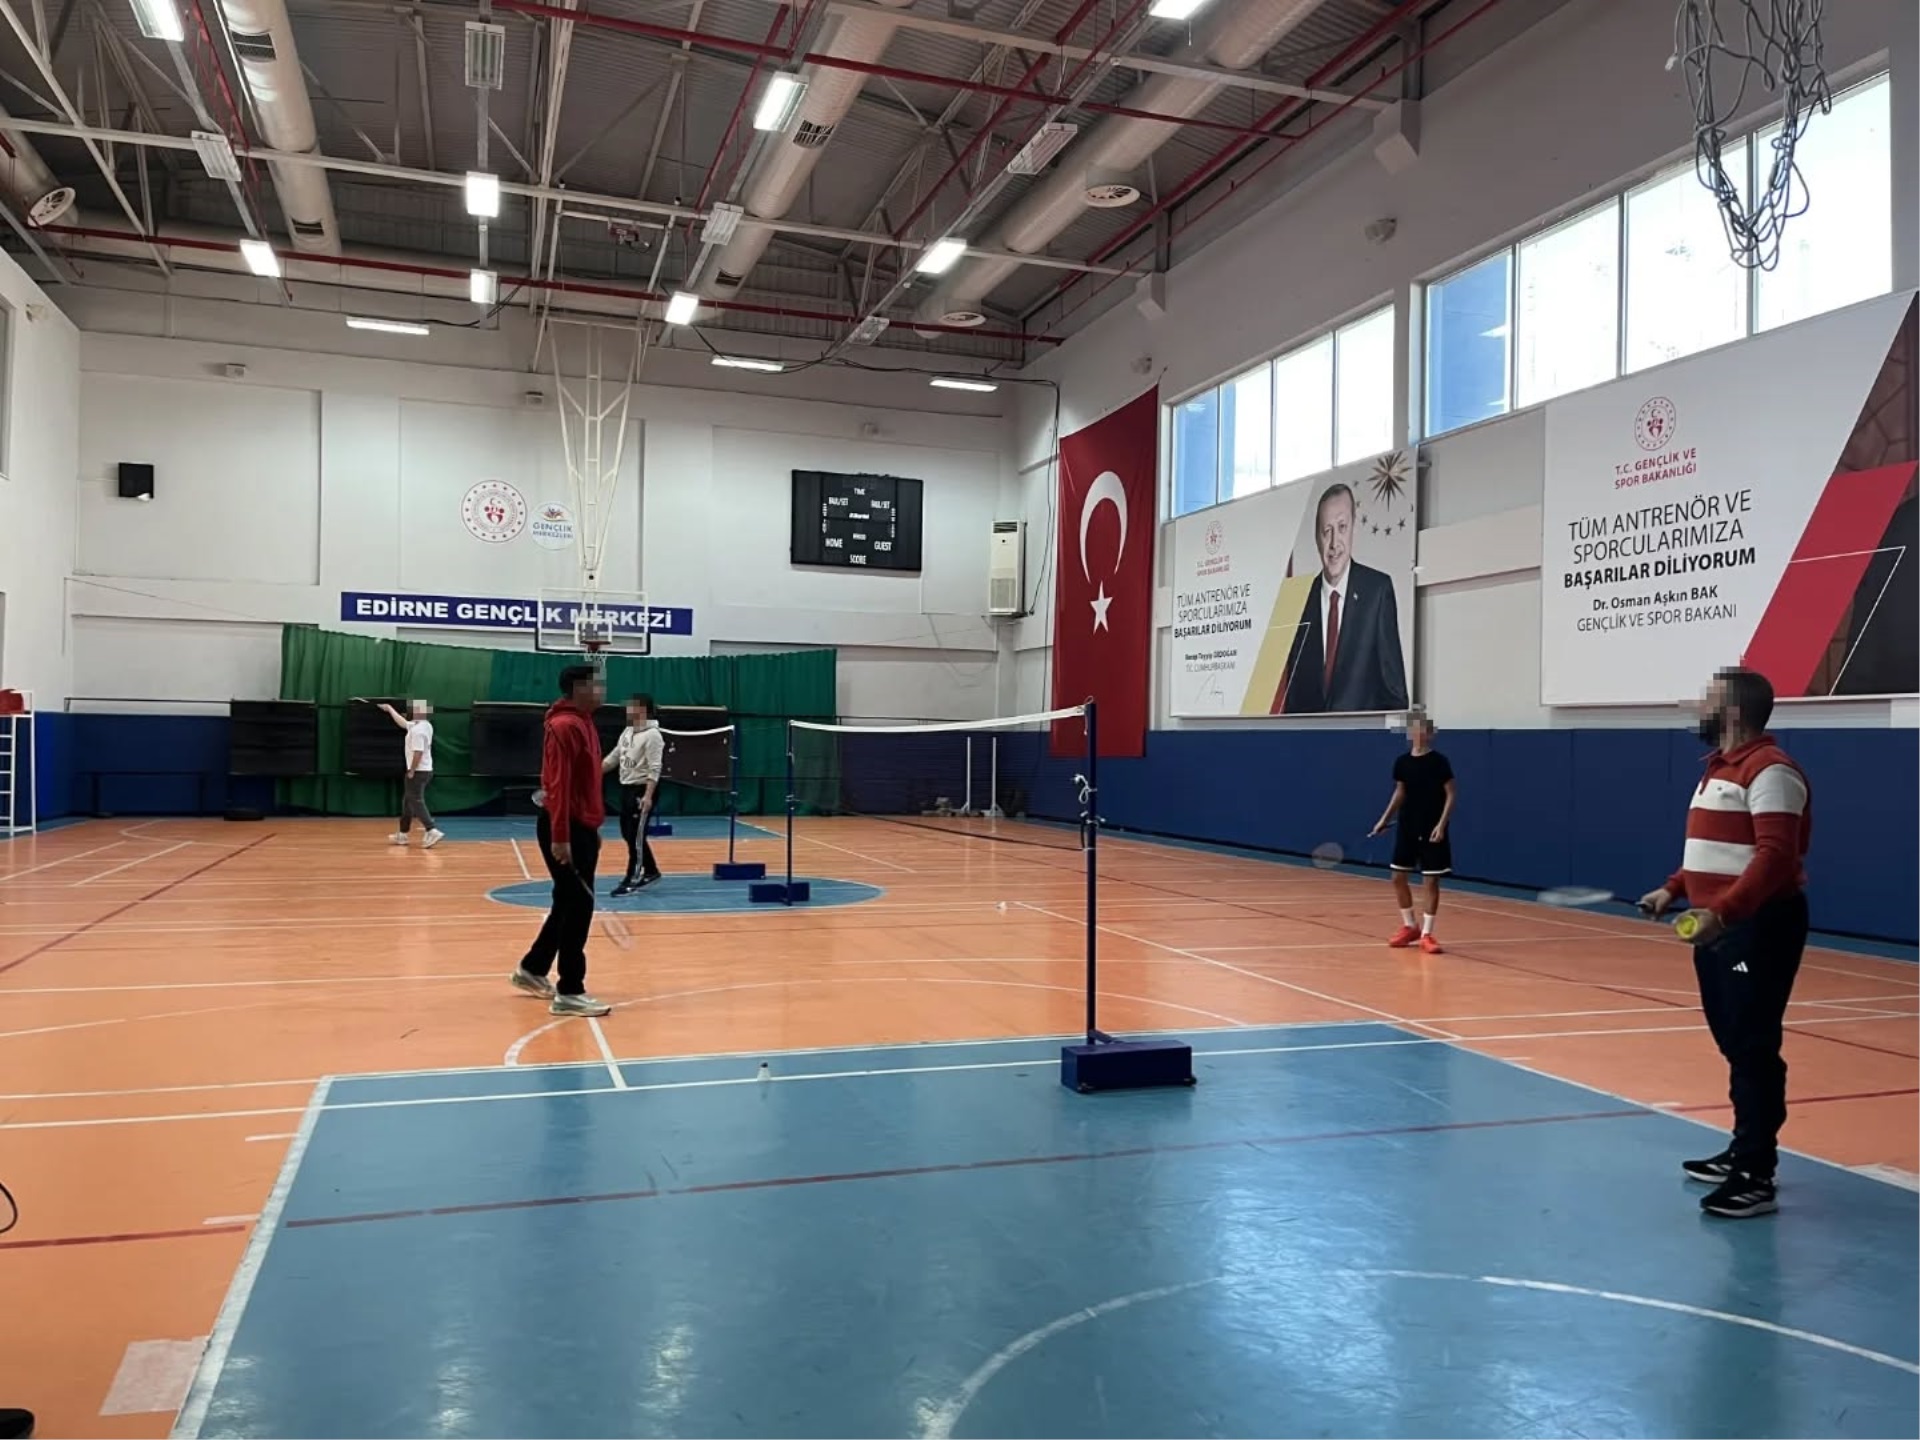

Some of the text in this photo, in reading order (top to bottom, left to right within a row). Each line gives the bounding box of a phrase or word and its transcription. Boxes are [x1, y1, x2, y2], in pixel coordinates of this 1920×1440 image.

[1615, 448, 1696, 475] T.C. GENÇLİK VE
[1615, 462, 1696, 489] SPOR BAKANLIĞI
[1568, 489, 1751, 541] TÜM ANTRENÖR VE
[874, 541, 892, 551] GUEST
[1573, 518, 1744, 564] SPORCULARIMIZA
[1564, 547, 1756, 589] BAŞARILAR DİLİYORUM
[1240, 583, 1251, 597] VE
[1593, 585, 1718, 611] Dr. Osman Aşkın BAK
[356, 597, 449, 618] EDİRNE
[456, 602, 562, 625] GENÇLİK
[1577, 604, 1737, 633] GENÇLİK VE SPOR BAKANI
[1174, 618, 1251, 640] BAŞARILAR DİLİYORUM
